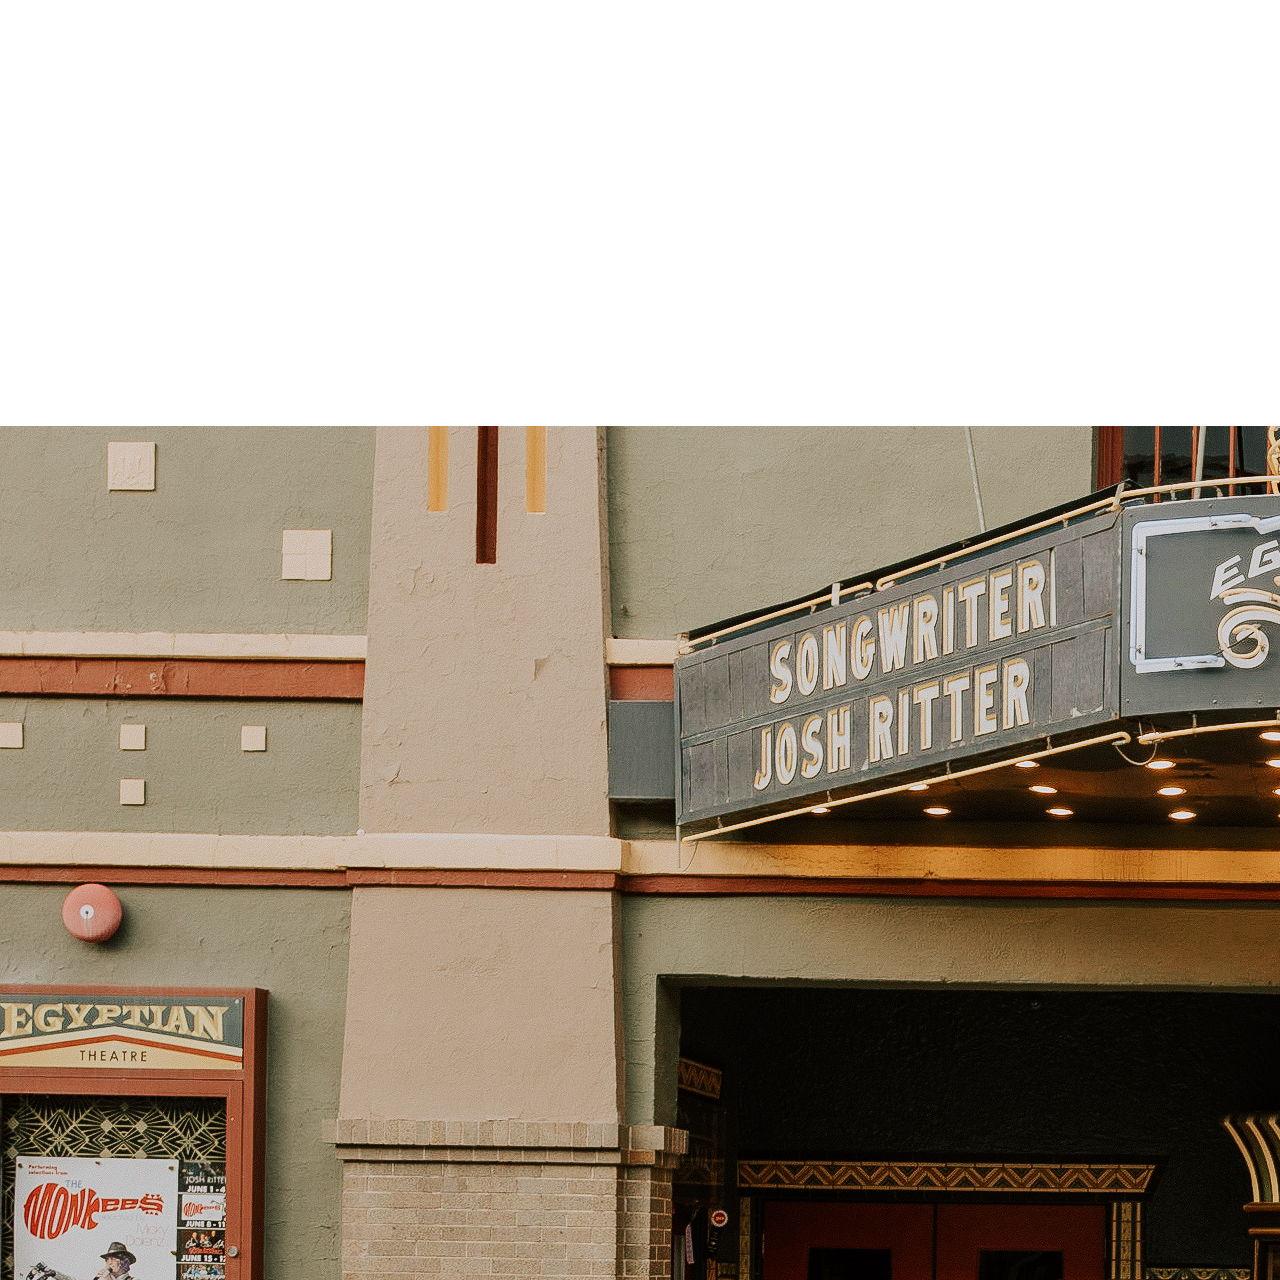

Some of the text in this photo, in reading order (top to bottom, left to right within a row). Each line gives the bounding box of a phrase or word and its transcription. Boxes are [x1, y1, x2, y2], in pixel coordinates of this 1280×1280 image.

[768, 558, 1047, 705] SONGWRITER
[753, 656, 1031, 792] JOSH RITTER
[0, 1002, 230, 1042] EGYPTIAN
[80, 1050, 148, 1062] THEATRE
[64, 1180, 83, 1189] THE
[187, 1185, 207, 1193] JUNE
[181, 1254, 202, 1262] JUNE
